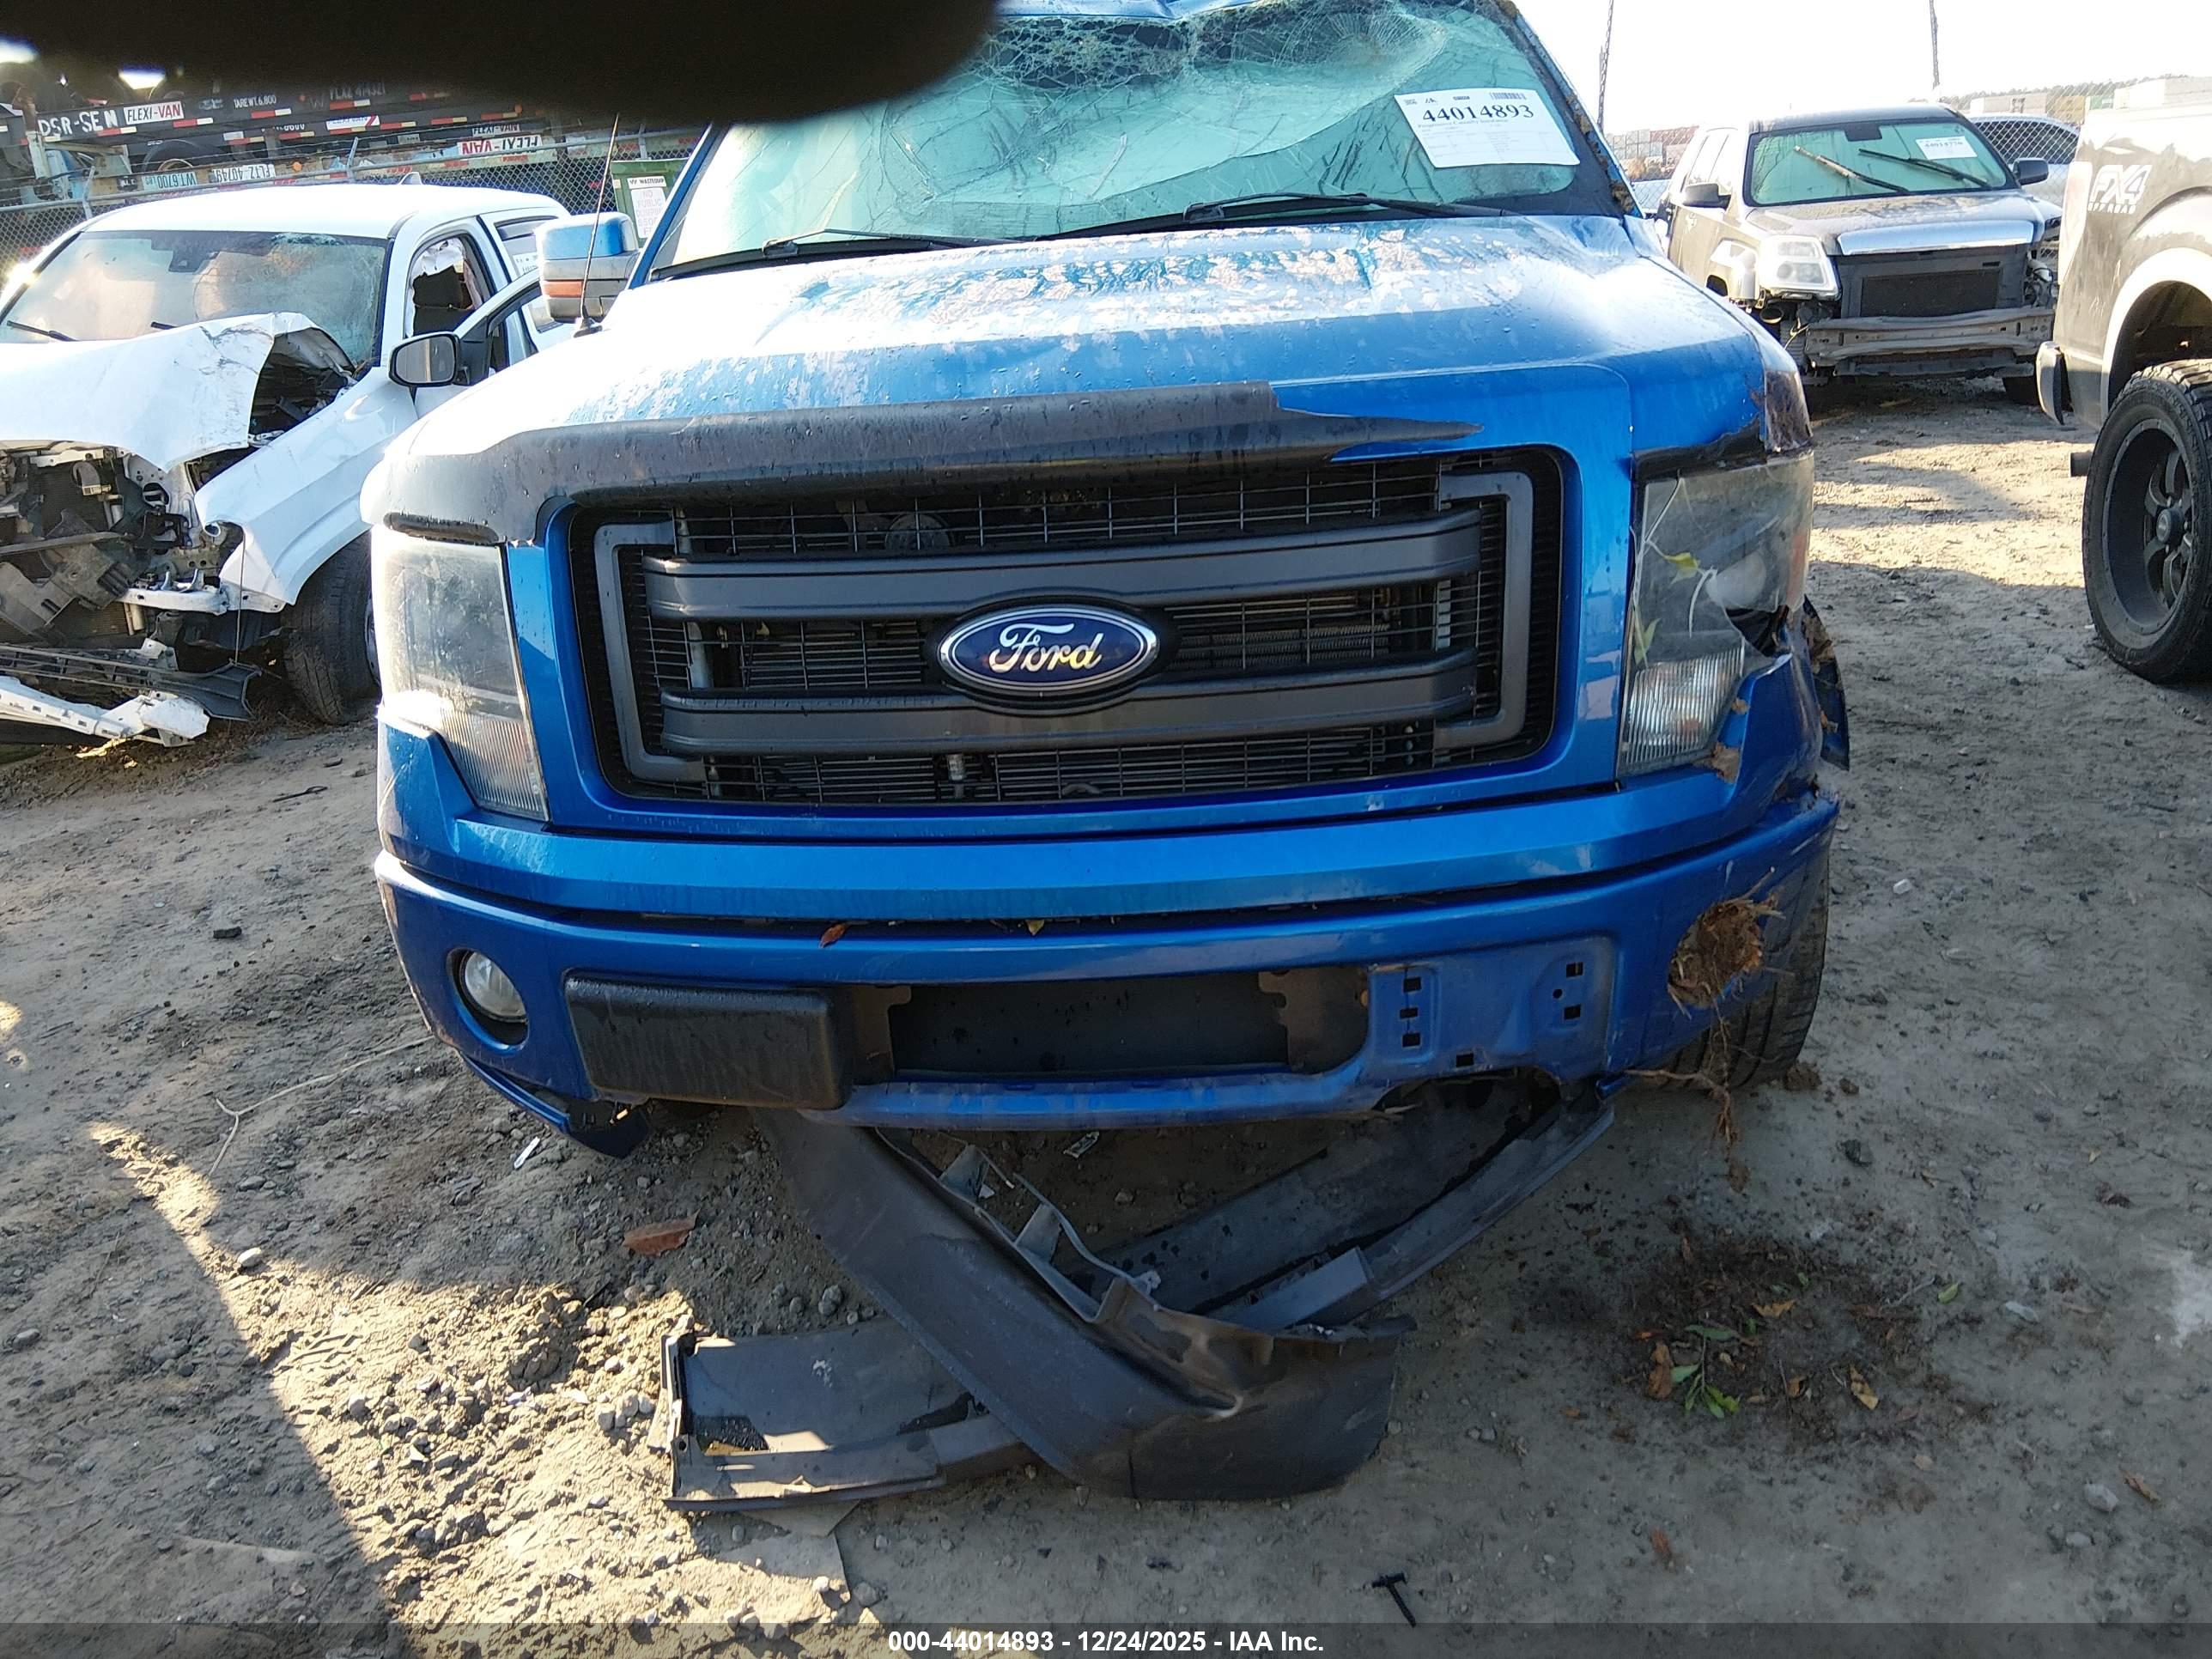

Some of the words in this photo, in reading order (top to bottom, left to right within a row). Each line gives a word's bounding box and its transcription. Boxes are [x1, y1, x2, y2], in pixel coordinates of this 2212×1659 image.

[128, 104, 181, 122] FLEXI-VAN
[1423, 104, 1534, 122] 44014893
[2088, 164, 2153, 204] FX4
[988, 623, 1104, 673] Ford
